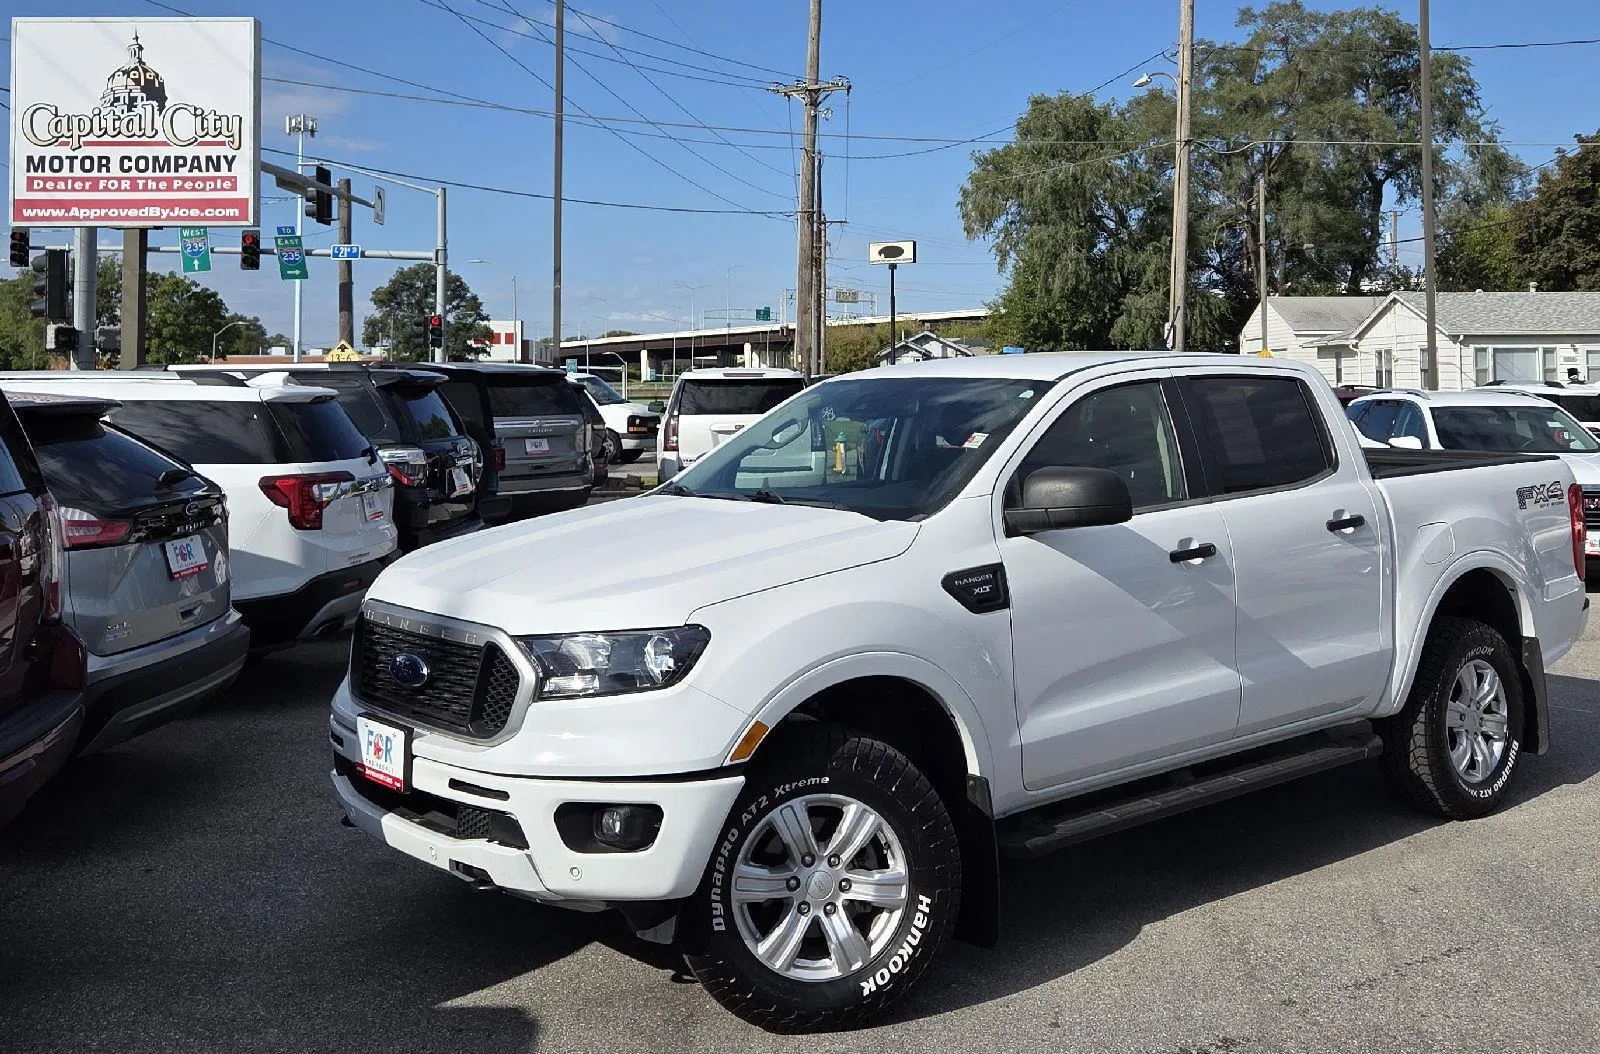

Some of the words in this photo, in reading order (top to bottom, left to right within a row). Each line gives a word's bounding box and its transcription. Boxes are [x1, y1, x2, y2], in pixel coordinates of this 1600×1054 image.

[22, 101, 158, 151] Capital
[162, 103, 242, 150] City
[26, 155, 110, 173] MOTOR
[119, 155, 237, 173] COMPANY
[33, 179, 92, 190] Dealer
[98, 179, 131, 190] FOR
[137, 179, 168, 190] The
[173, 179, 232, 192] People
[22, 206, 240, 219] www.ApprovedByJoe.com
[183, 228, 205, 236] WEST
[186, 242, 205, 253] 235
[282, 251, 301, 261] 235
[1516, 481, 1564, 510] FX4
[954, 573, 993, 586] RANGER
[973, 585, 993, 595] XLT
[366, 729, 394, 765] FOR
[741, 795, 769, 827] AT2
[773, 776, 830, 798] Xtreme
